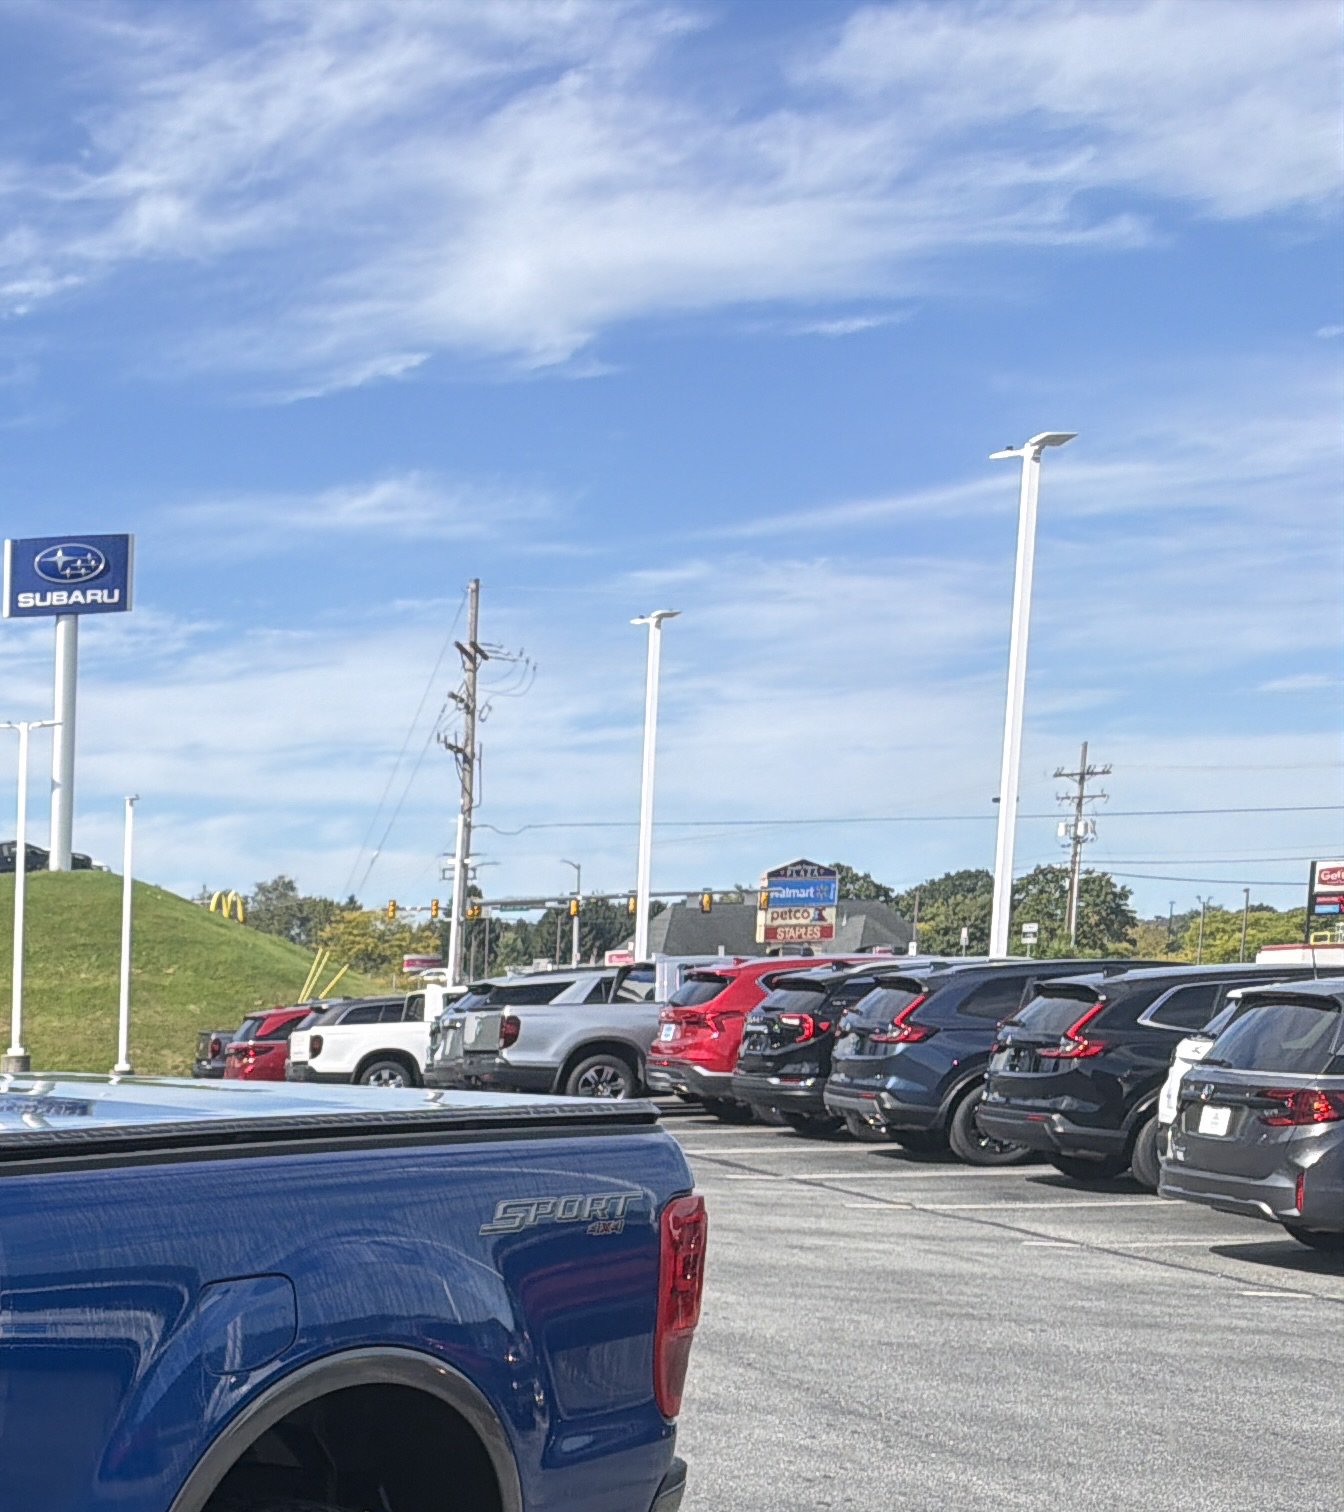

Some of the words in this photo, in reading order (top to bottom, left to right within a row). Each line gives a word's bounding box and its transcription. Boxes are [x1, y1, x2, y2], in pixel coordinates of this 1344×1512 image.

[17, 588, 120, 608] SUBARU
[770, 908, 811, 923] petco
[776, 926, 821, 940] STAPLES
[479, 1190, 644, 1235] SPORT
